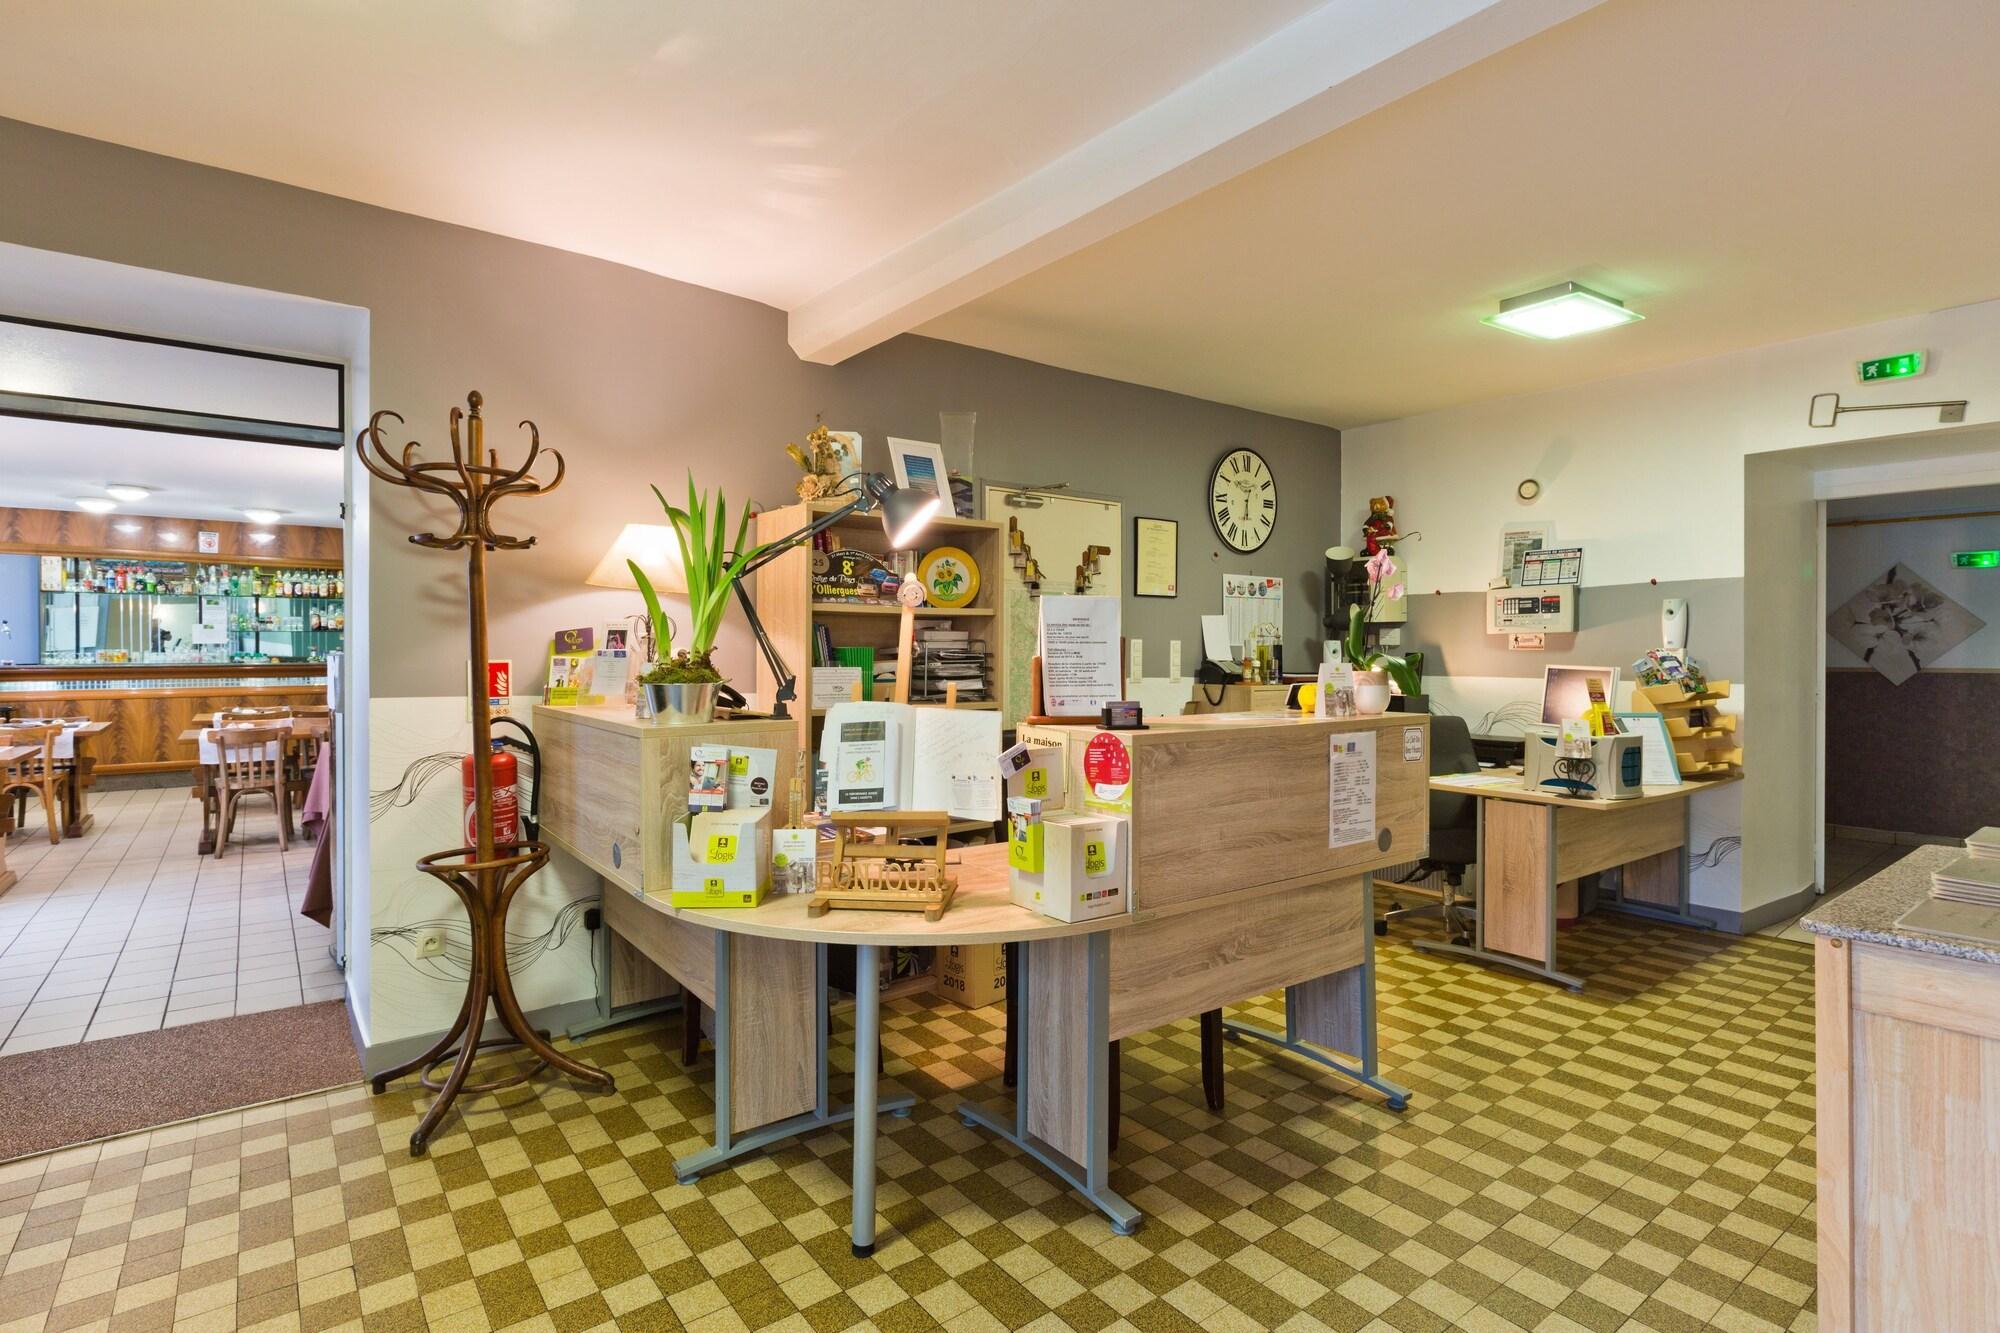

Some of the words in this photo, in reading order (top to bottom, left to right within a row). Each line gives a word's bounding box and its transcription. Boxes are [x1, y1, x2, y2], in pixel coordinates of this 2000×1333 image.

[1022, 734, 1032, 744] La
[1033, 737, 1063, 748] maison
[816, 862, 939, 892] BONJOUR
[943, 975, 966, 992] 2018
[994, 976, 1006, 989] 20
